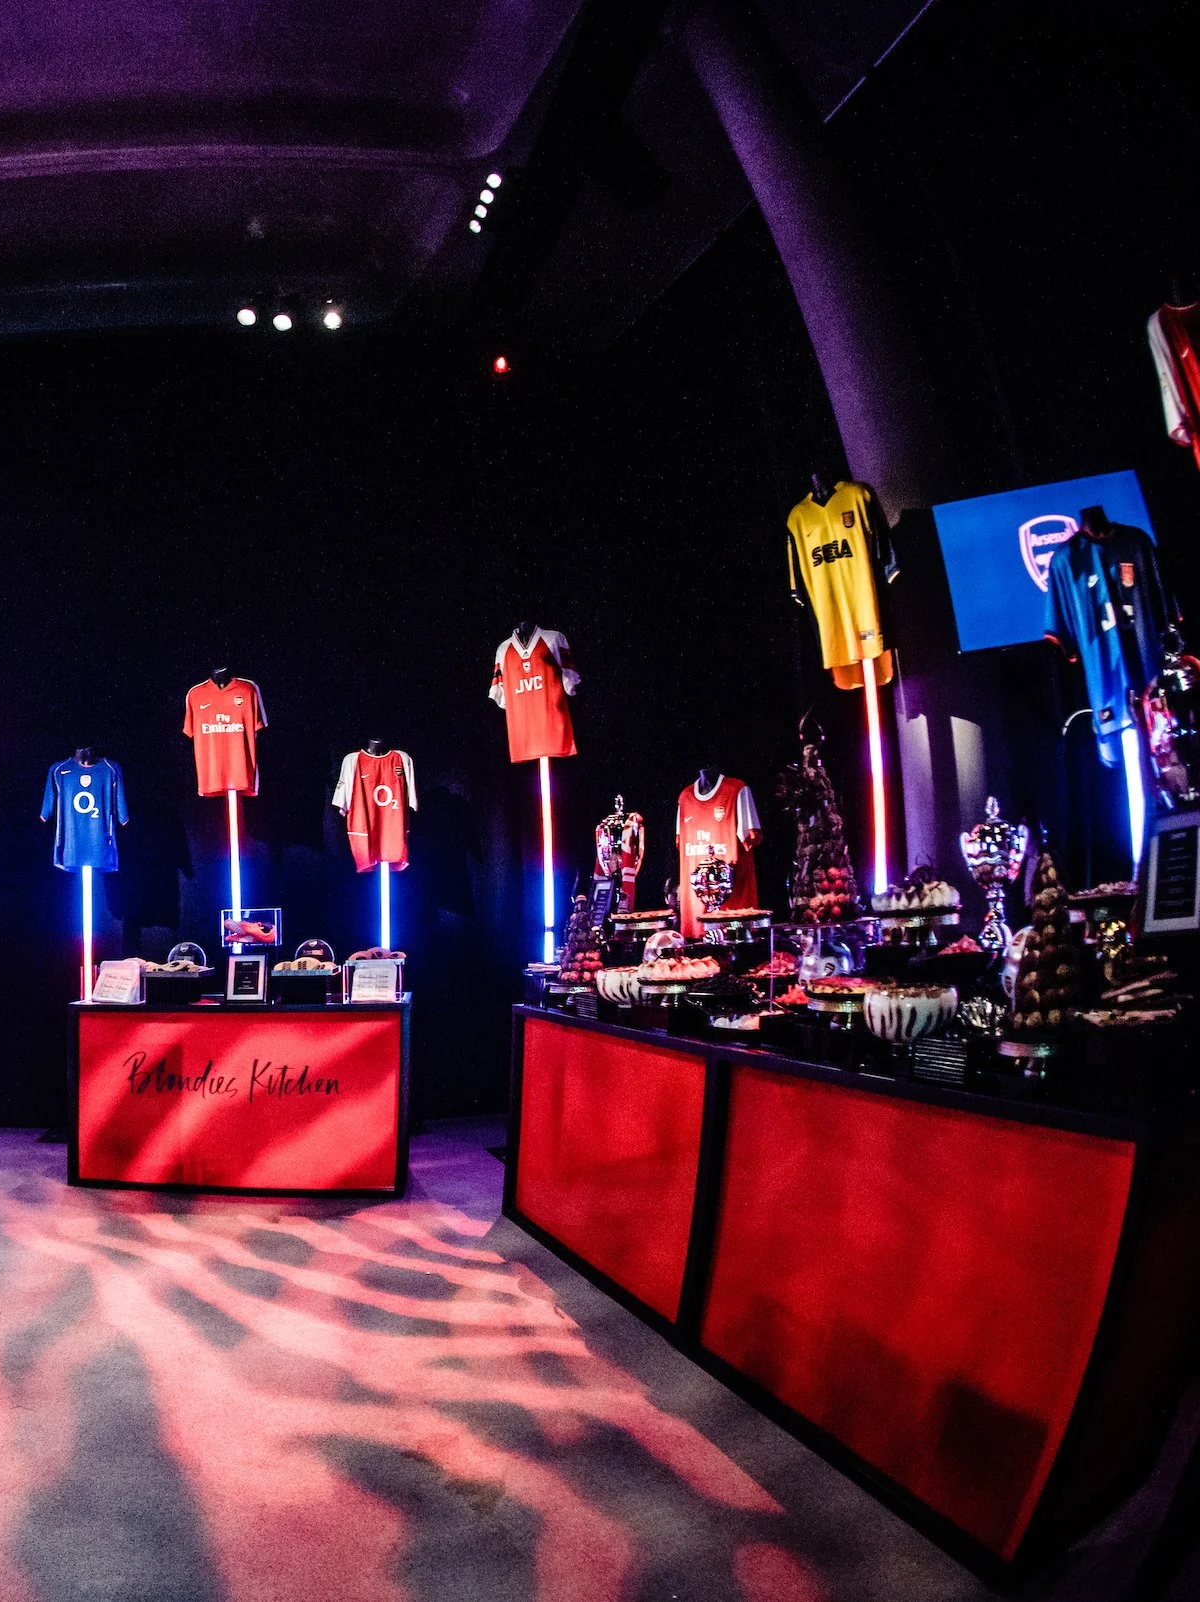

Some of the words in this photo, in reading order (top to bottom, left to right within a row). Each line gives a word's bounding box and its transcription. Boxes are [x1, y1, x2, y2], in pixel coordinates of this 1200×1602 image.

[515, 675, 543, 694] JVC
[215, 713, 231, 723] Fly
[201, 722, 244, 734] Emirates
[122, 1051, 238, 1100] Blondies
[249, 1058, 339, 1104] Kitchen
